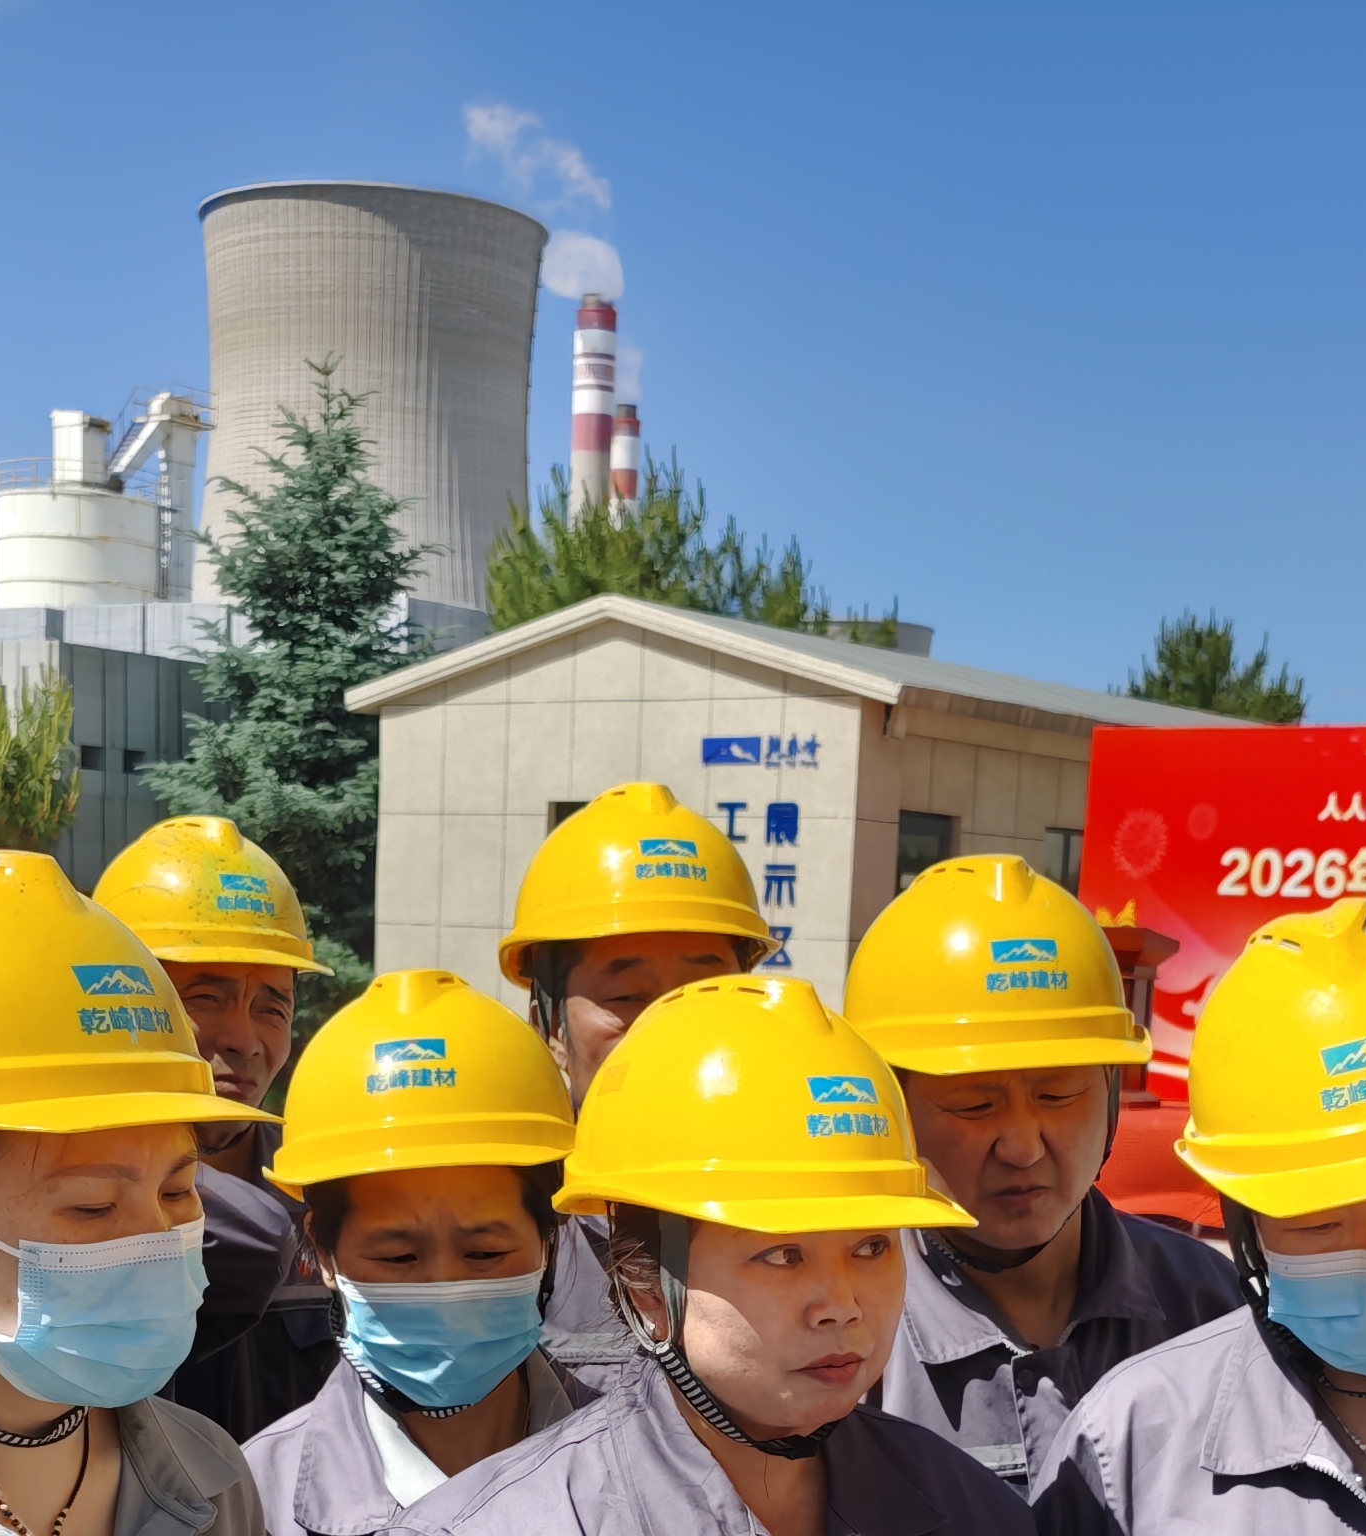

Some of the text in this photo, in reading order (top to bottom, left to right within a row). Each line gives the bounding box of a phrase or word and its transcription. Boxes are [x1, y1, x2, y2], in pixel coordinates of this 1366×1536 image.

[634, 862, 707, 882] 乾峰建材
[985, 971, 1068, 991] 乾峰建材
[76, 1006, 173, 1034] 乾峰建材
[366, 1067, 457, 1094] 乾峰建材
[806, 1113, 890, 1137] 乾峰建材
